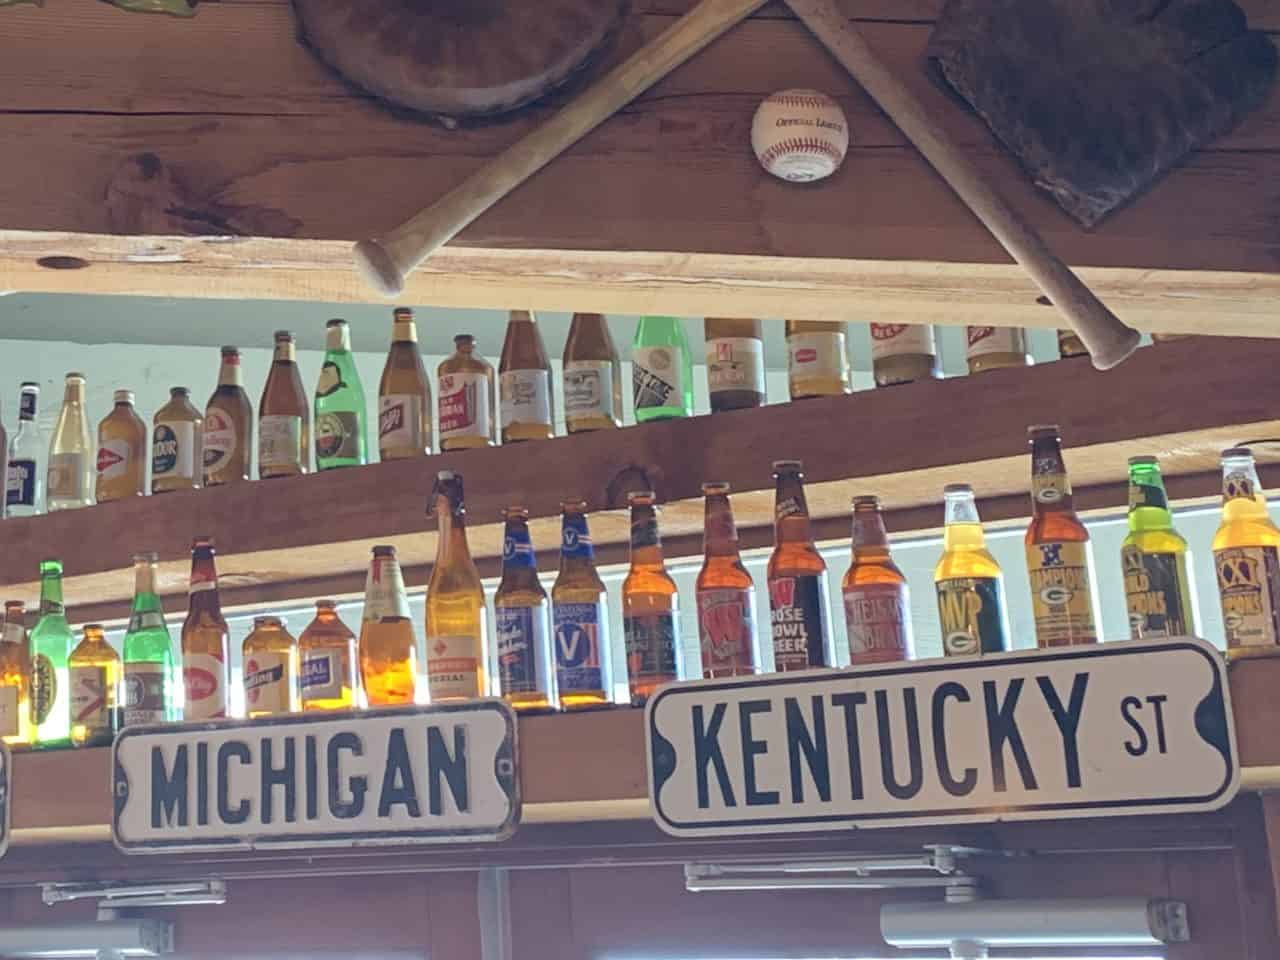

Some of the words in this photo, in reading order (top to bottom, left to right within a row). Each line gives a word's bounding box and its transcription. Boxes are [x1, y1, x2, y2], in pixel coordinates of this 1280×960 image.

[558, 631, 580, 661] V
[150, 724, 471, 829] MICHIGAN
[691, 671, 1090, 810] KENTUCKY
[1121, 695, 1168, 757] ST
